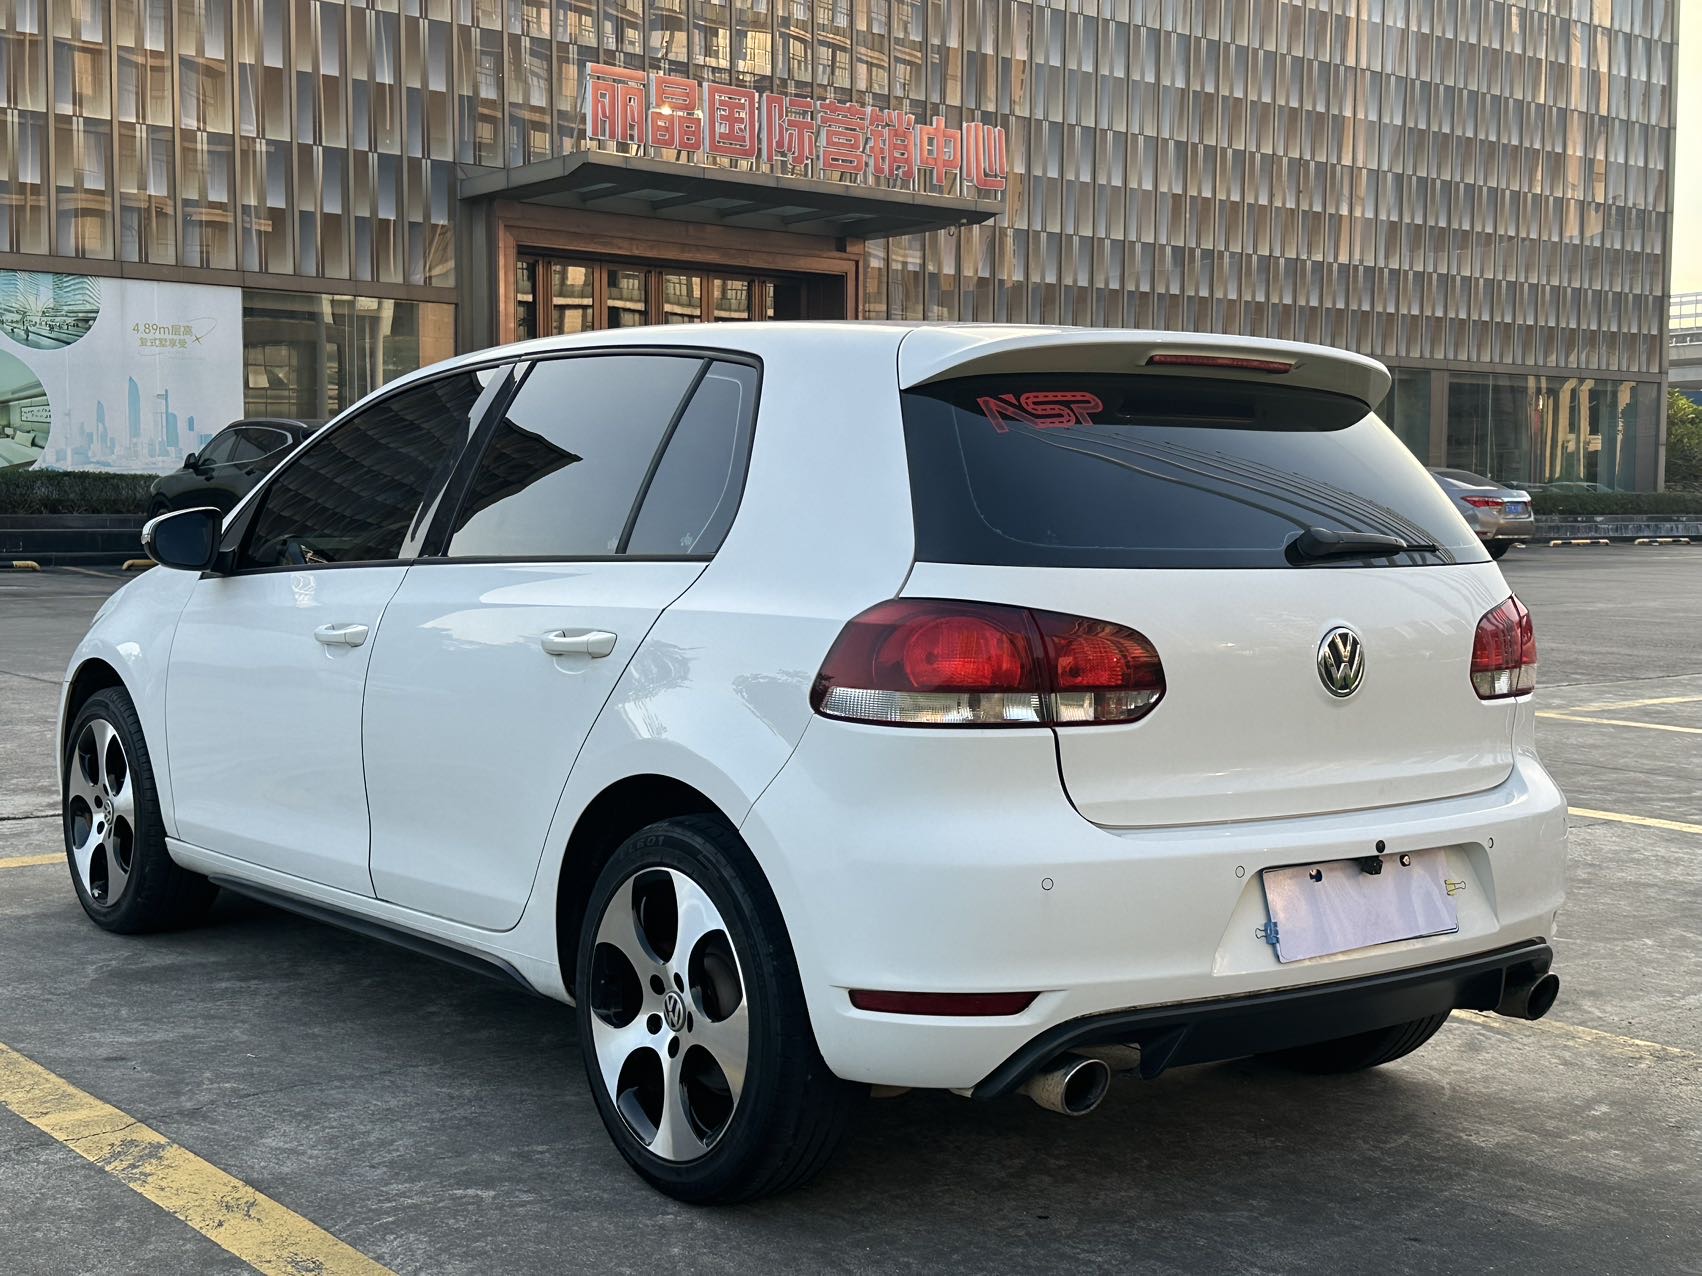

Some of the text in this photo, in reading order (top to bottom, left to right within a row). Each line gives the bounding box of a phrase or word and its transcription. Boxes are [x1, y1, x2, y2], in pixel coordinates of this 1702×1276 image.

[586, 62, 1007, 190] 丽晶国际营销中心
[976, 391, 1104, 433] NSP
